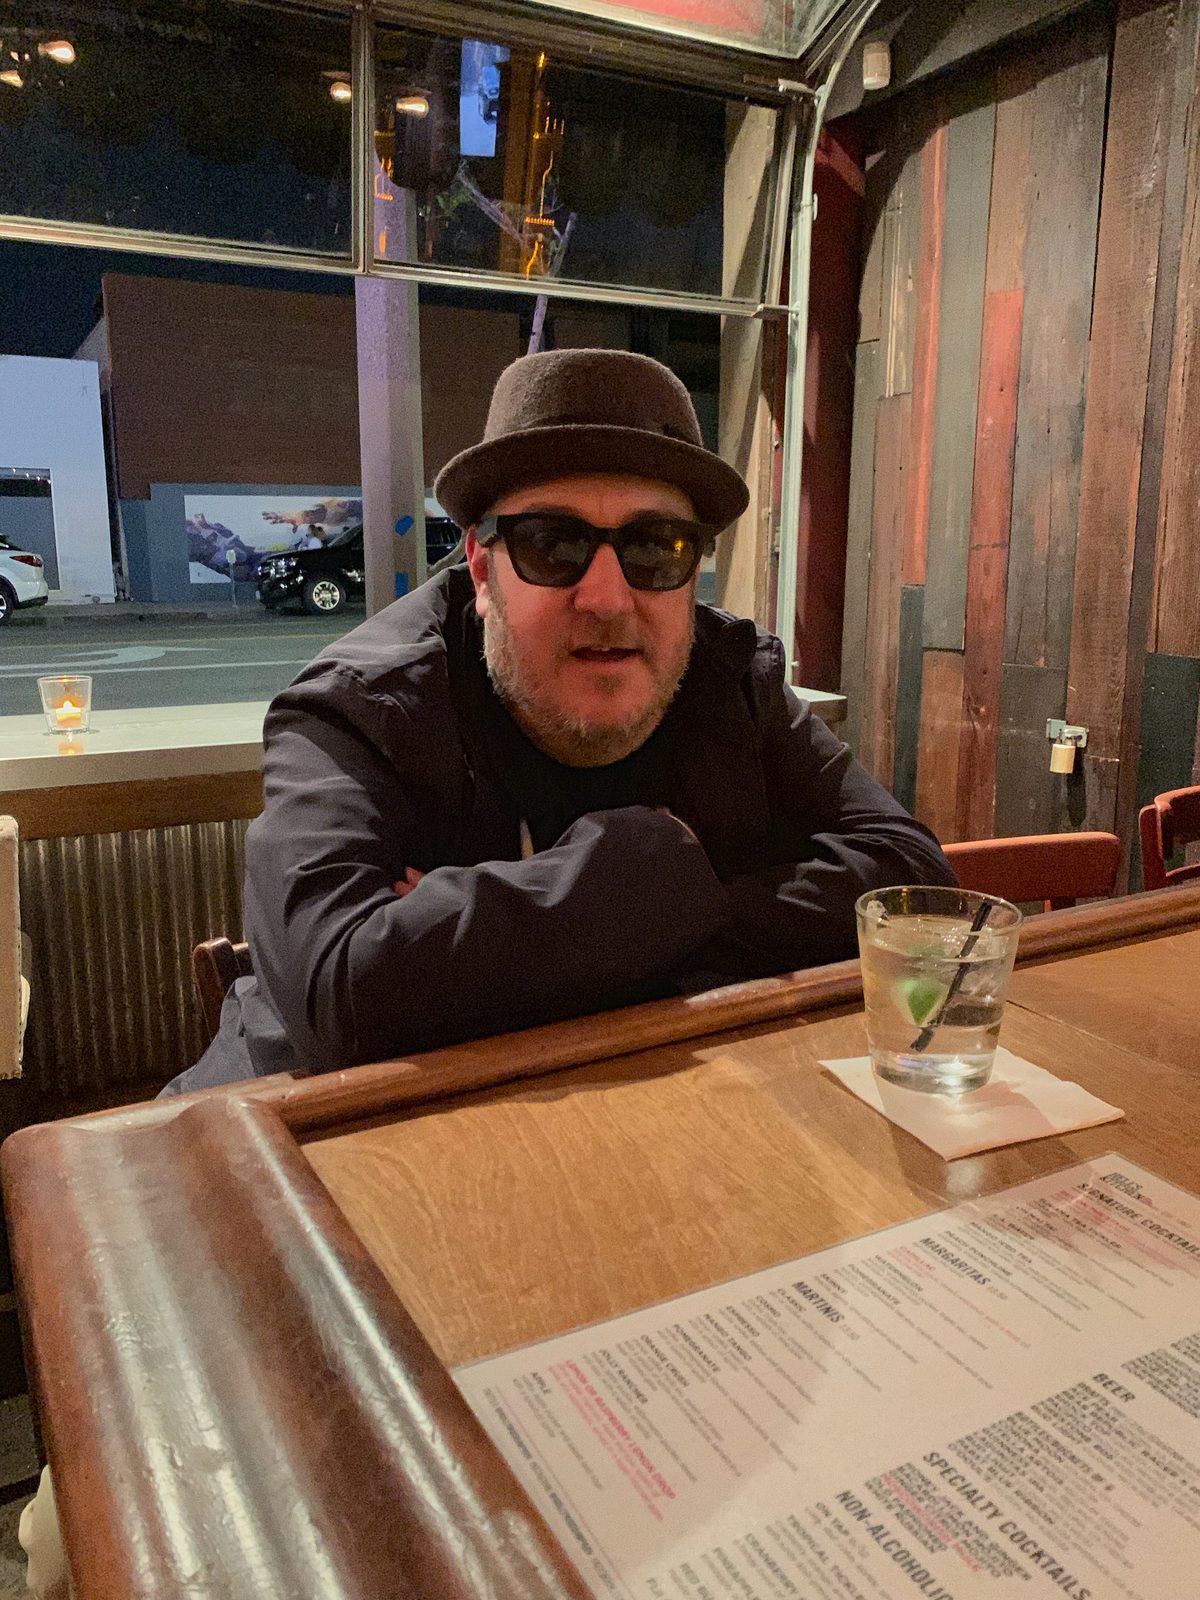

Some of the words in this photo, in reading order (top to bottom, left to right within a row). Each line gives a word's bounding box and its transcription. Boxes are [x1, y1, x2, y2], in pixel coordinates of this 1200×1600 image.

[1138, 1217, 1200, 1256] COCKTAIL
[917, 1235, 993, 1287] MARGARITAS
[789, 1279, 848, 1324] MARTINIS
[1090, 1371, 1138, 1404] BEER
[833, 1488, 955, 1600] NON-ALCOHOLIC
[919, 1449, 1006, 1523] SPECIALTY
[995, 1518, 1093, 1600] COCKTAILS
